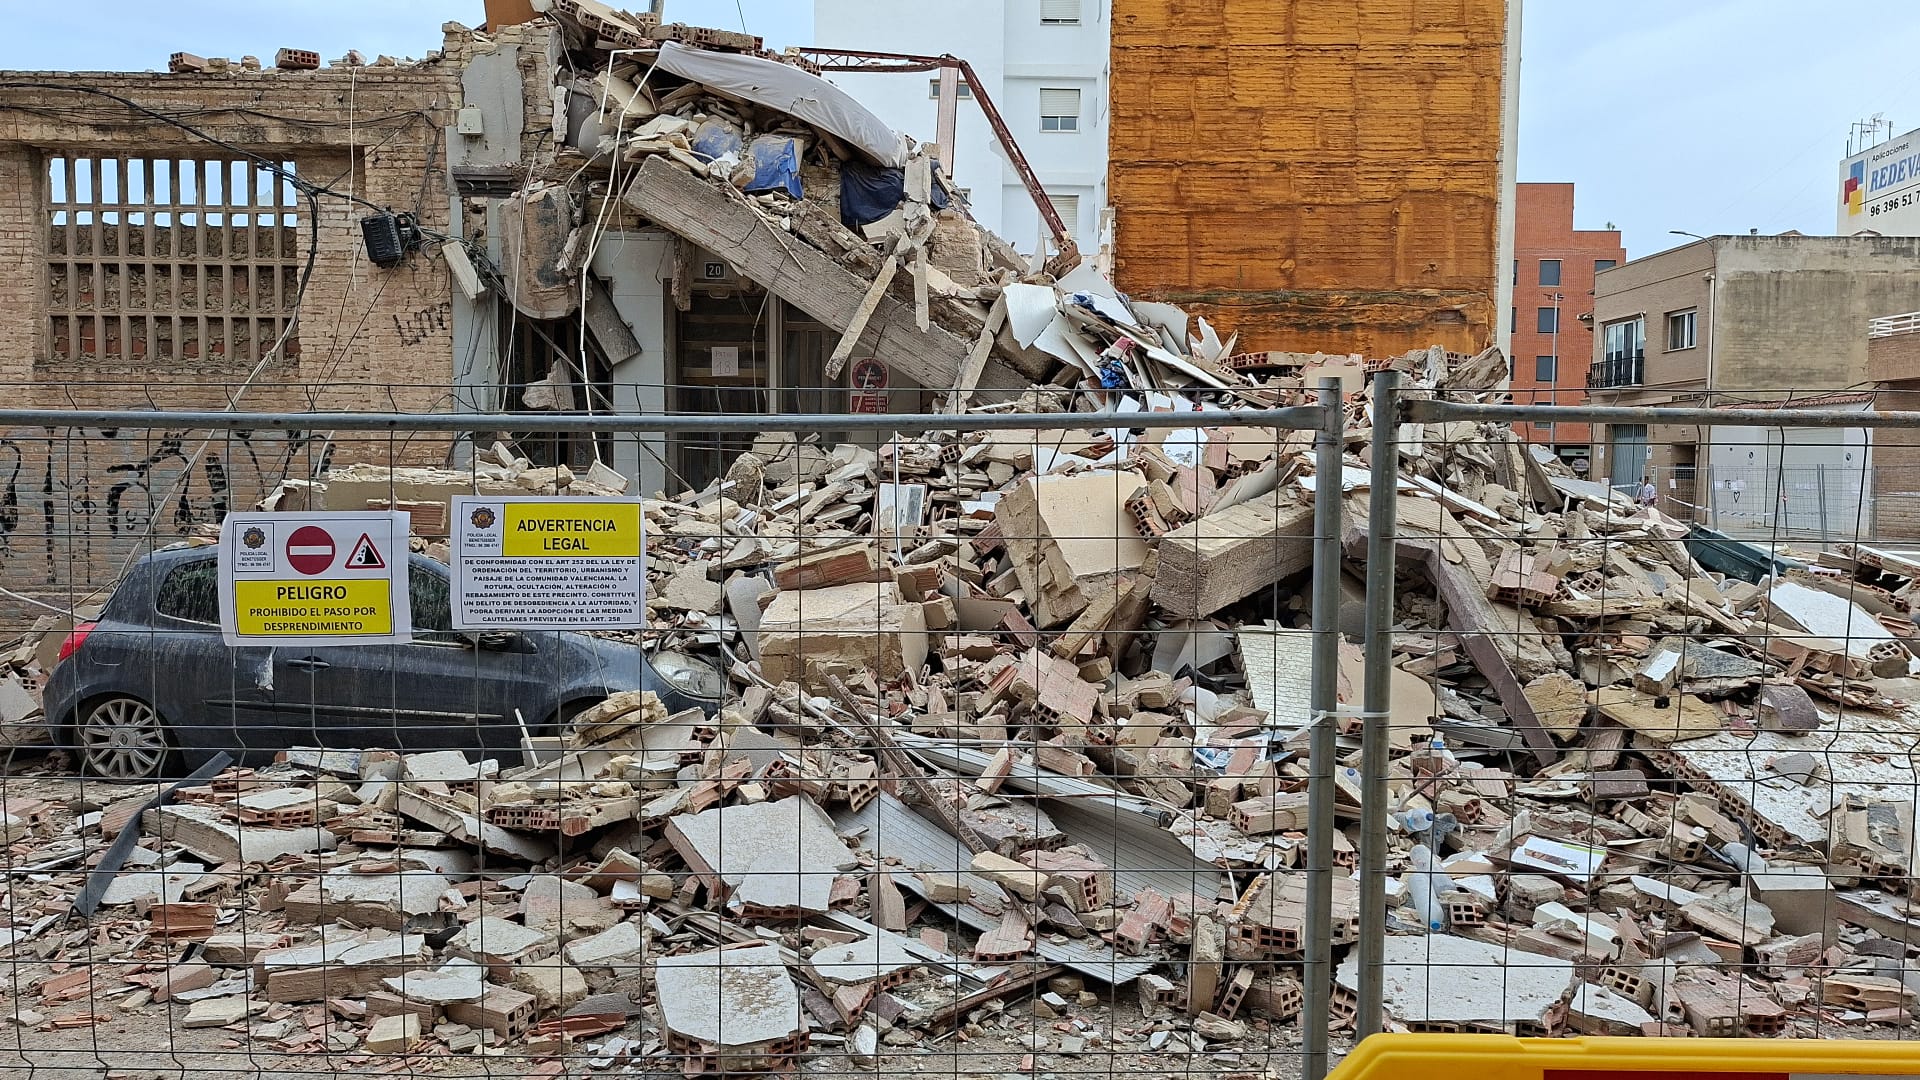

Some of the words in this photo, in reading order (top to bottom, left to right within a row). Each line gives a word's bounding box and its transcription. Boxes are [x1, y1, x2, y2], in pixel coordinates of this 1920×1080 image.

[1872, 142, 1909, 162] Aplicaciones
[1870, 204, 1880, 217] 96
[1883, 198, 1899, 213] 396
[1902, 193, 1913, 207] 51
[709, 265, 721, 276] 20
[517, 519, 617, 532] ADVERTENCIA
[543, 537, 590, 551] LEGAL
[277, 585, 347, 600] PELIGRO
[249, 608, 307, 617] PROHIBIDO
[310, 607, 321, 617] EL
[324, 607, 351, 616] PASO
[353, 606, 377, 616] POR
[263, 621, 363, 632] DESPRENDIMIENTO
